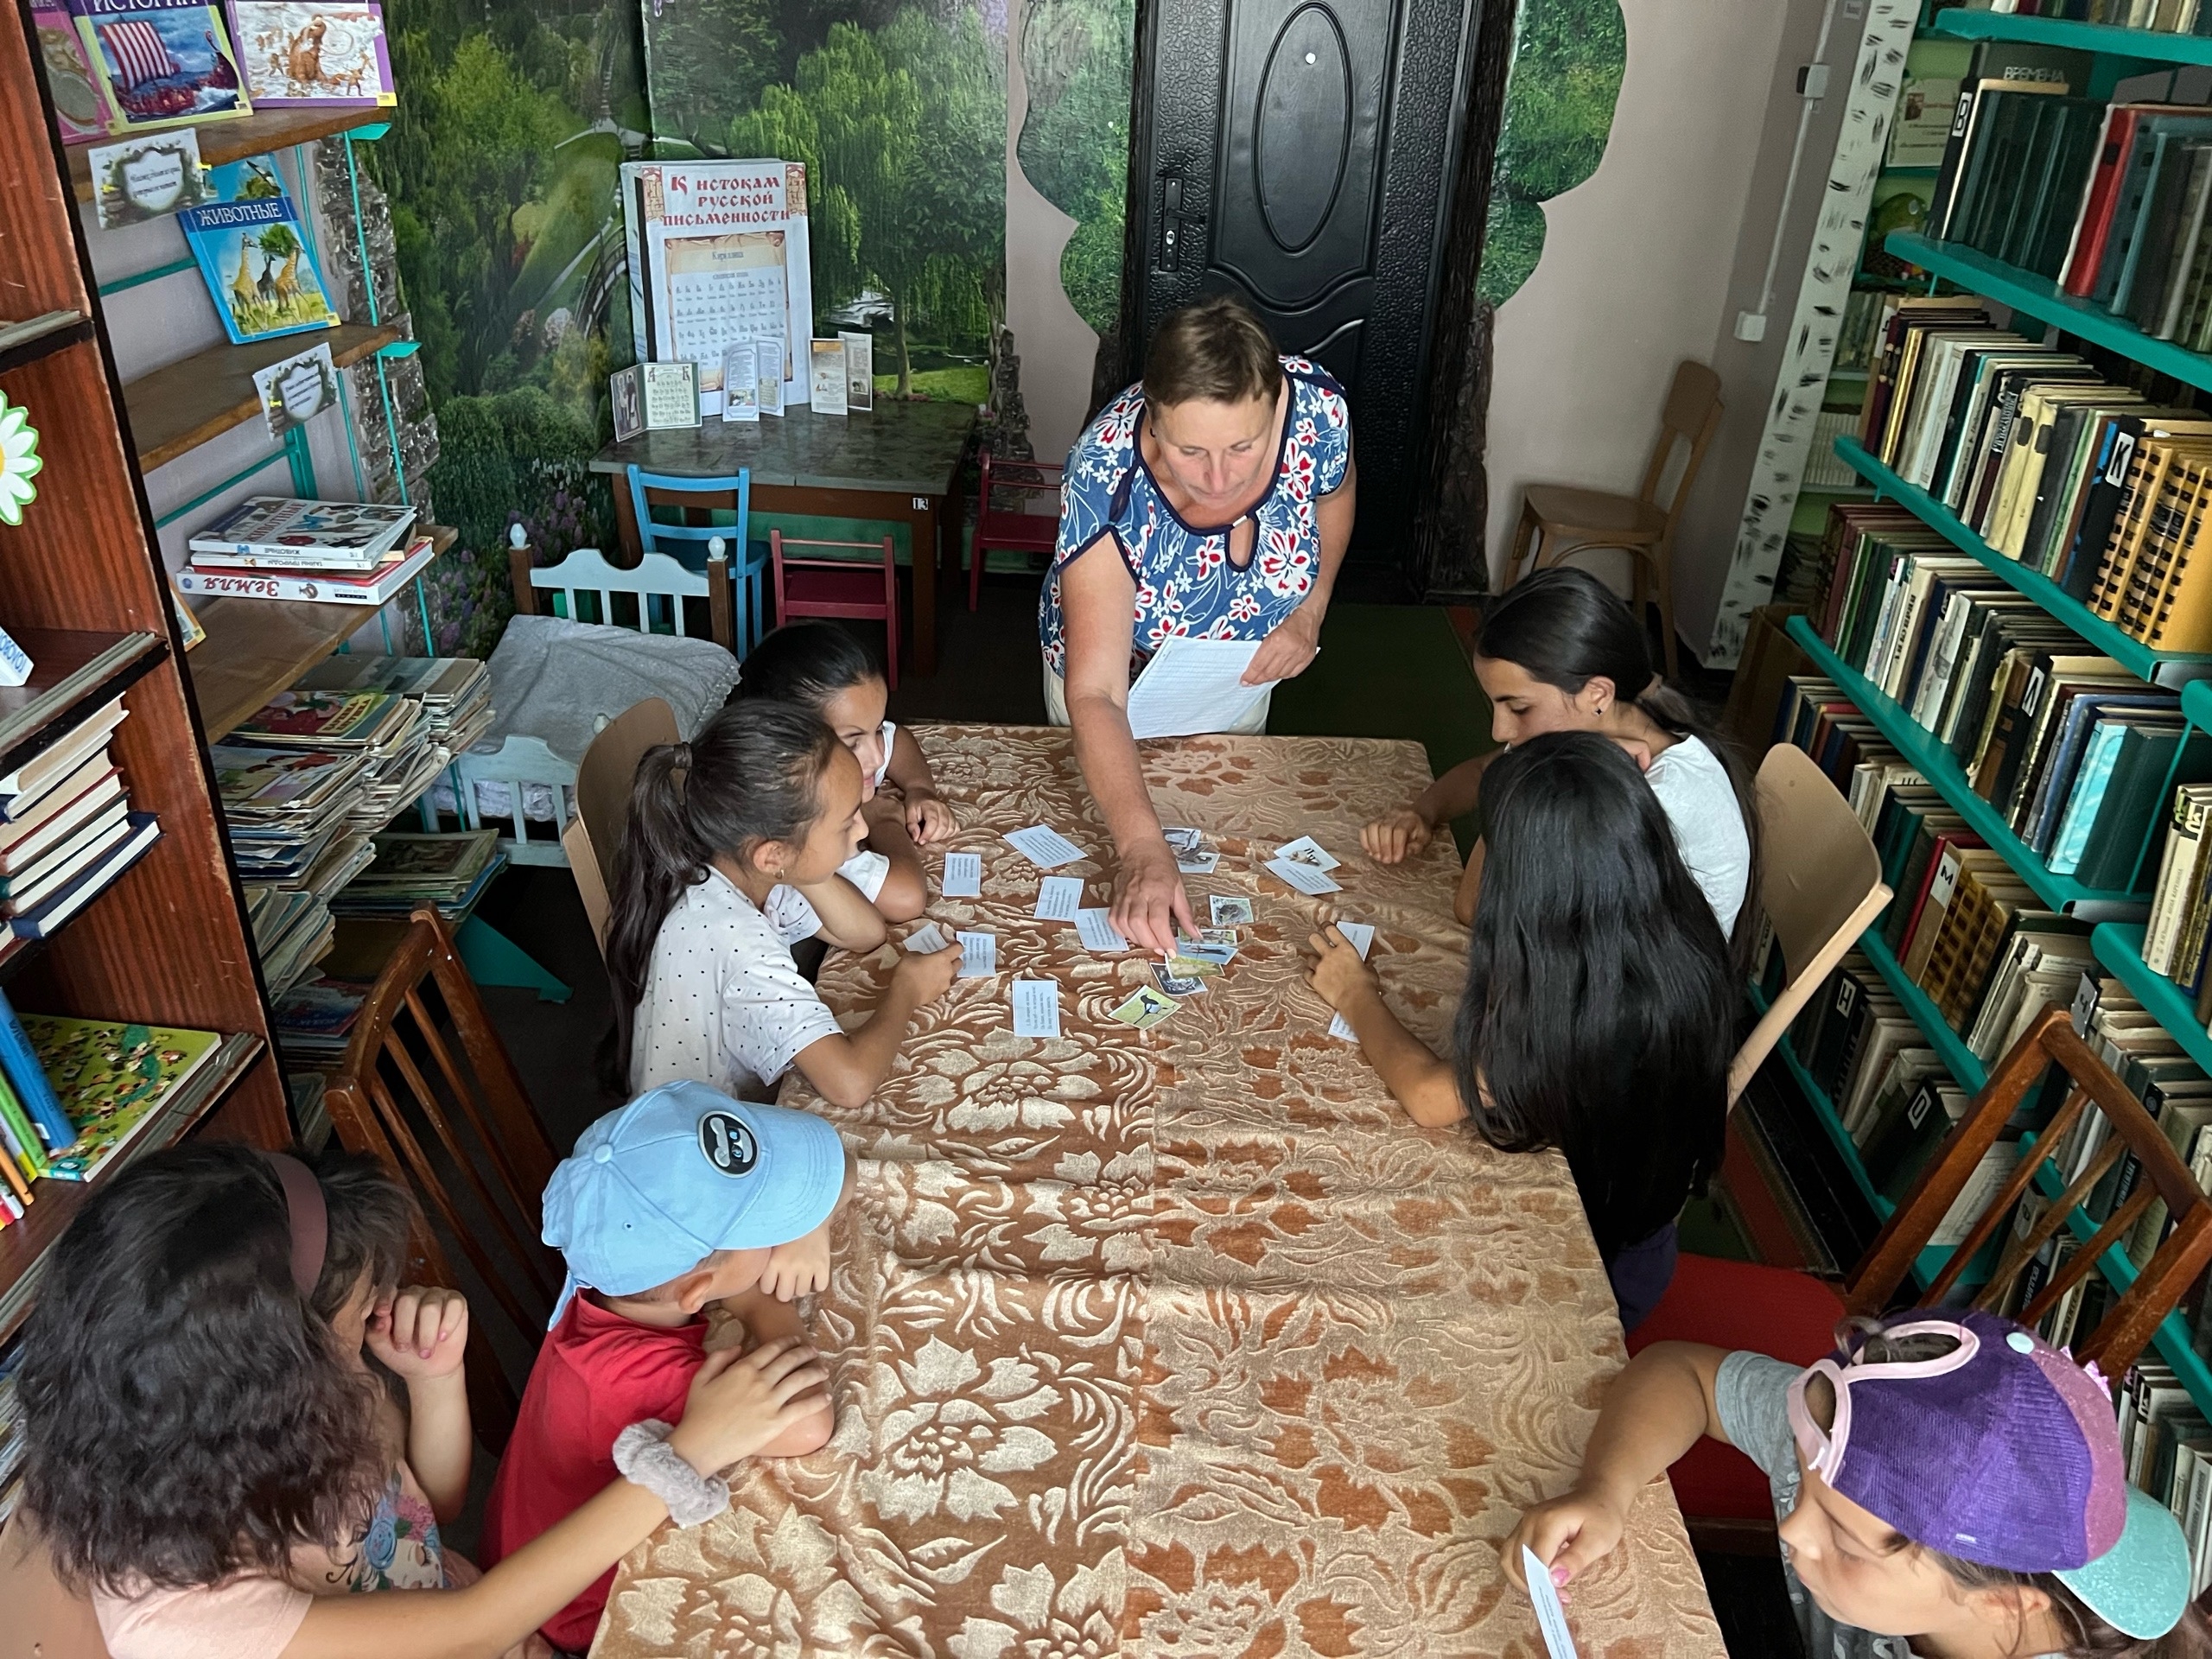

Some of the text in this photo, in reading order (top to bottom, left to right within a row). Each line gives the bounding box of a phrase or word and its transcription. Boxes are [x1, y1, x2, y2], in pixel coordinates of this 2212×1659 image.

[671, 175, 780, 195] К ИСТОКАМ
[698, 191, 773, 212] РУССКОЙ
[199, 202, 283, 226] ЖИВОТНЫЕ
[663, 210, 790, 226] ПИСЬМЕННОСТИ
[2111, 440, 2132, 480] К
[1941, 864, 1954, 887] М
[1839, 982, 1853, 1012] Н
